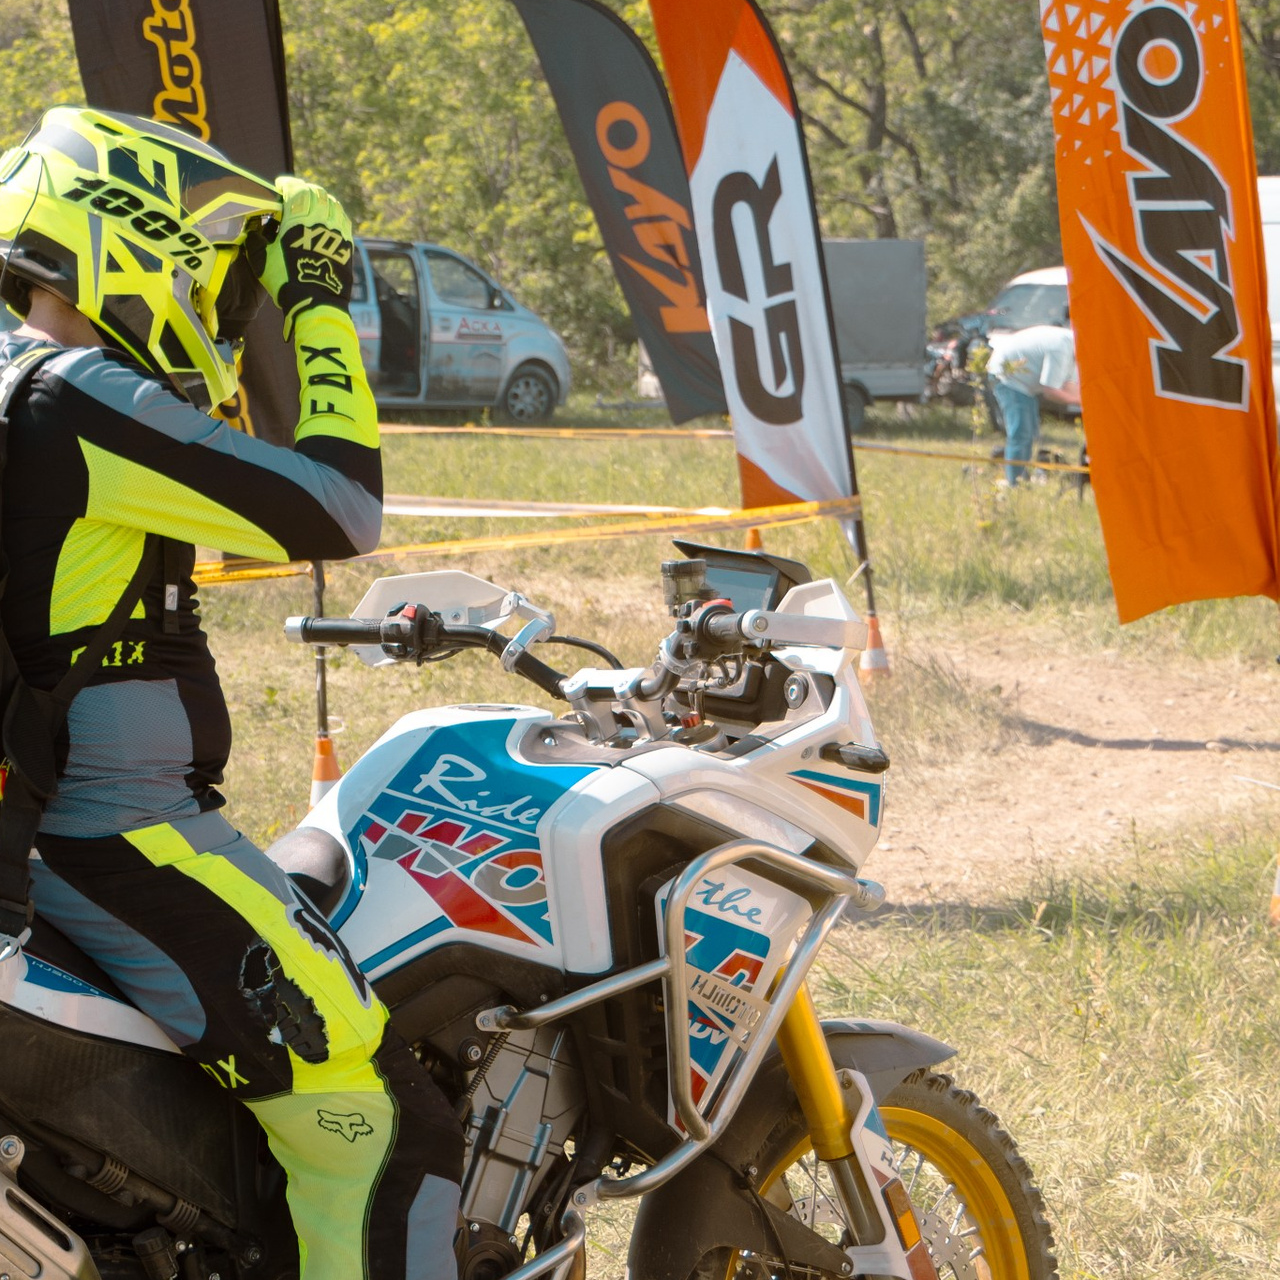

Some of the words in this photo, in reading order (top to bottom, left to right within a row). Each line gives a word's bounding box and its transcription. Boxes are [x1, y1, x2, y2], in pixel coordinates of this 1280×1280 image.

[61, 175, 215, 273] 100%
[289, 225, 353, 267] FOX
[595, 100, 712, 333] KAYO
[1077, 0, 1250, 412] KAYO
[712, 152, 805, 425] GR
[299, 344, 358, 423] FOX
[412, 753, 542, 825] Ride
[695, 879, 763, 926] the
